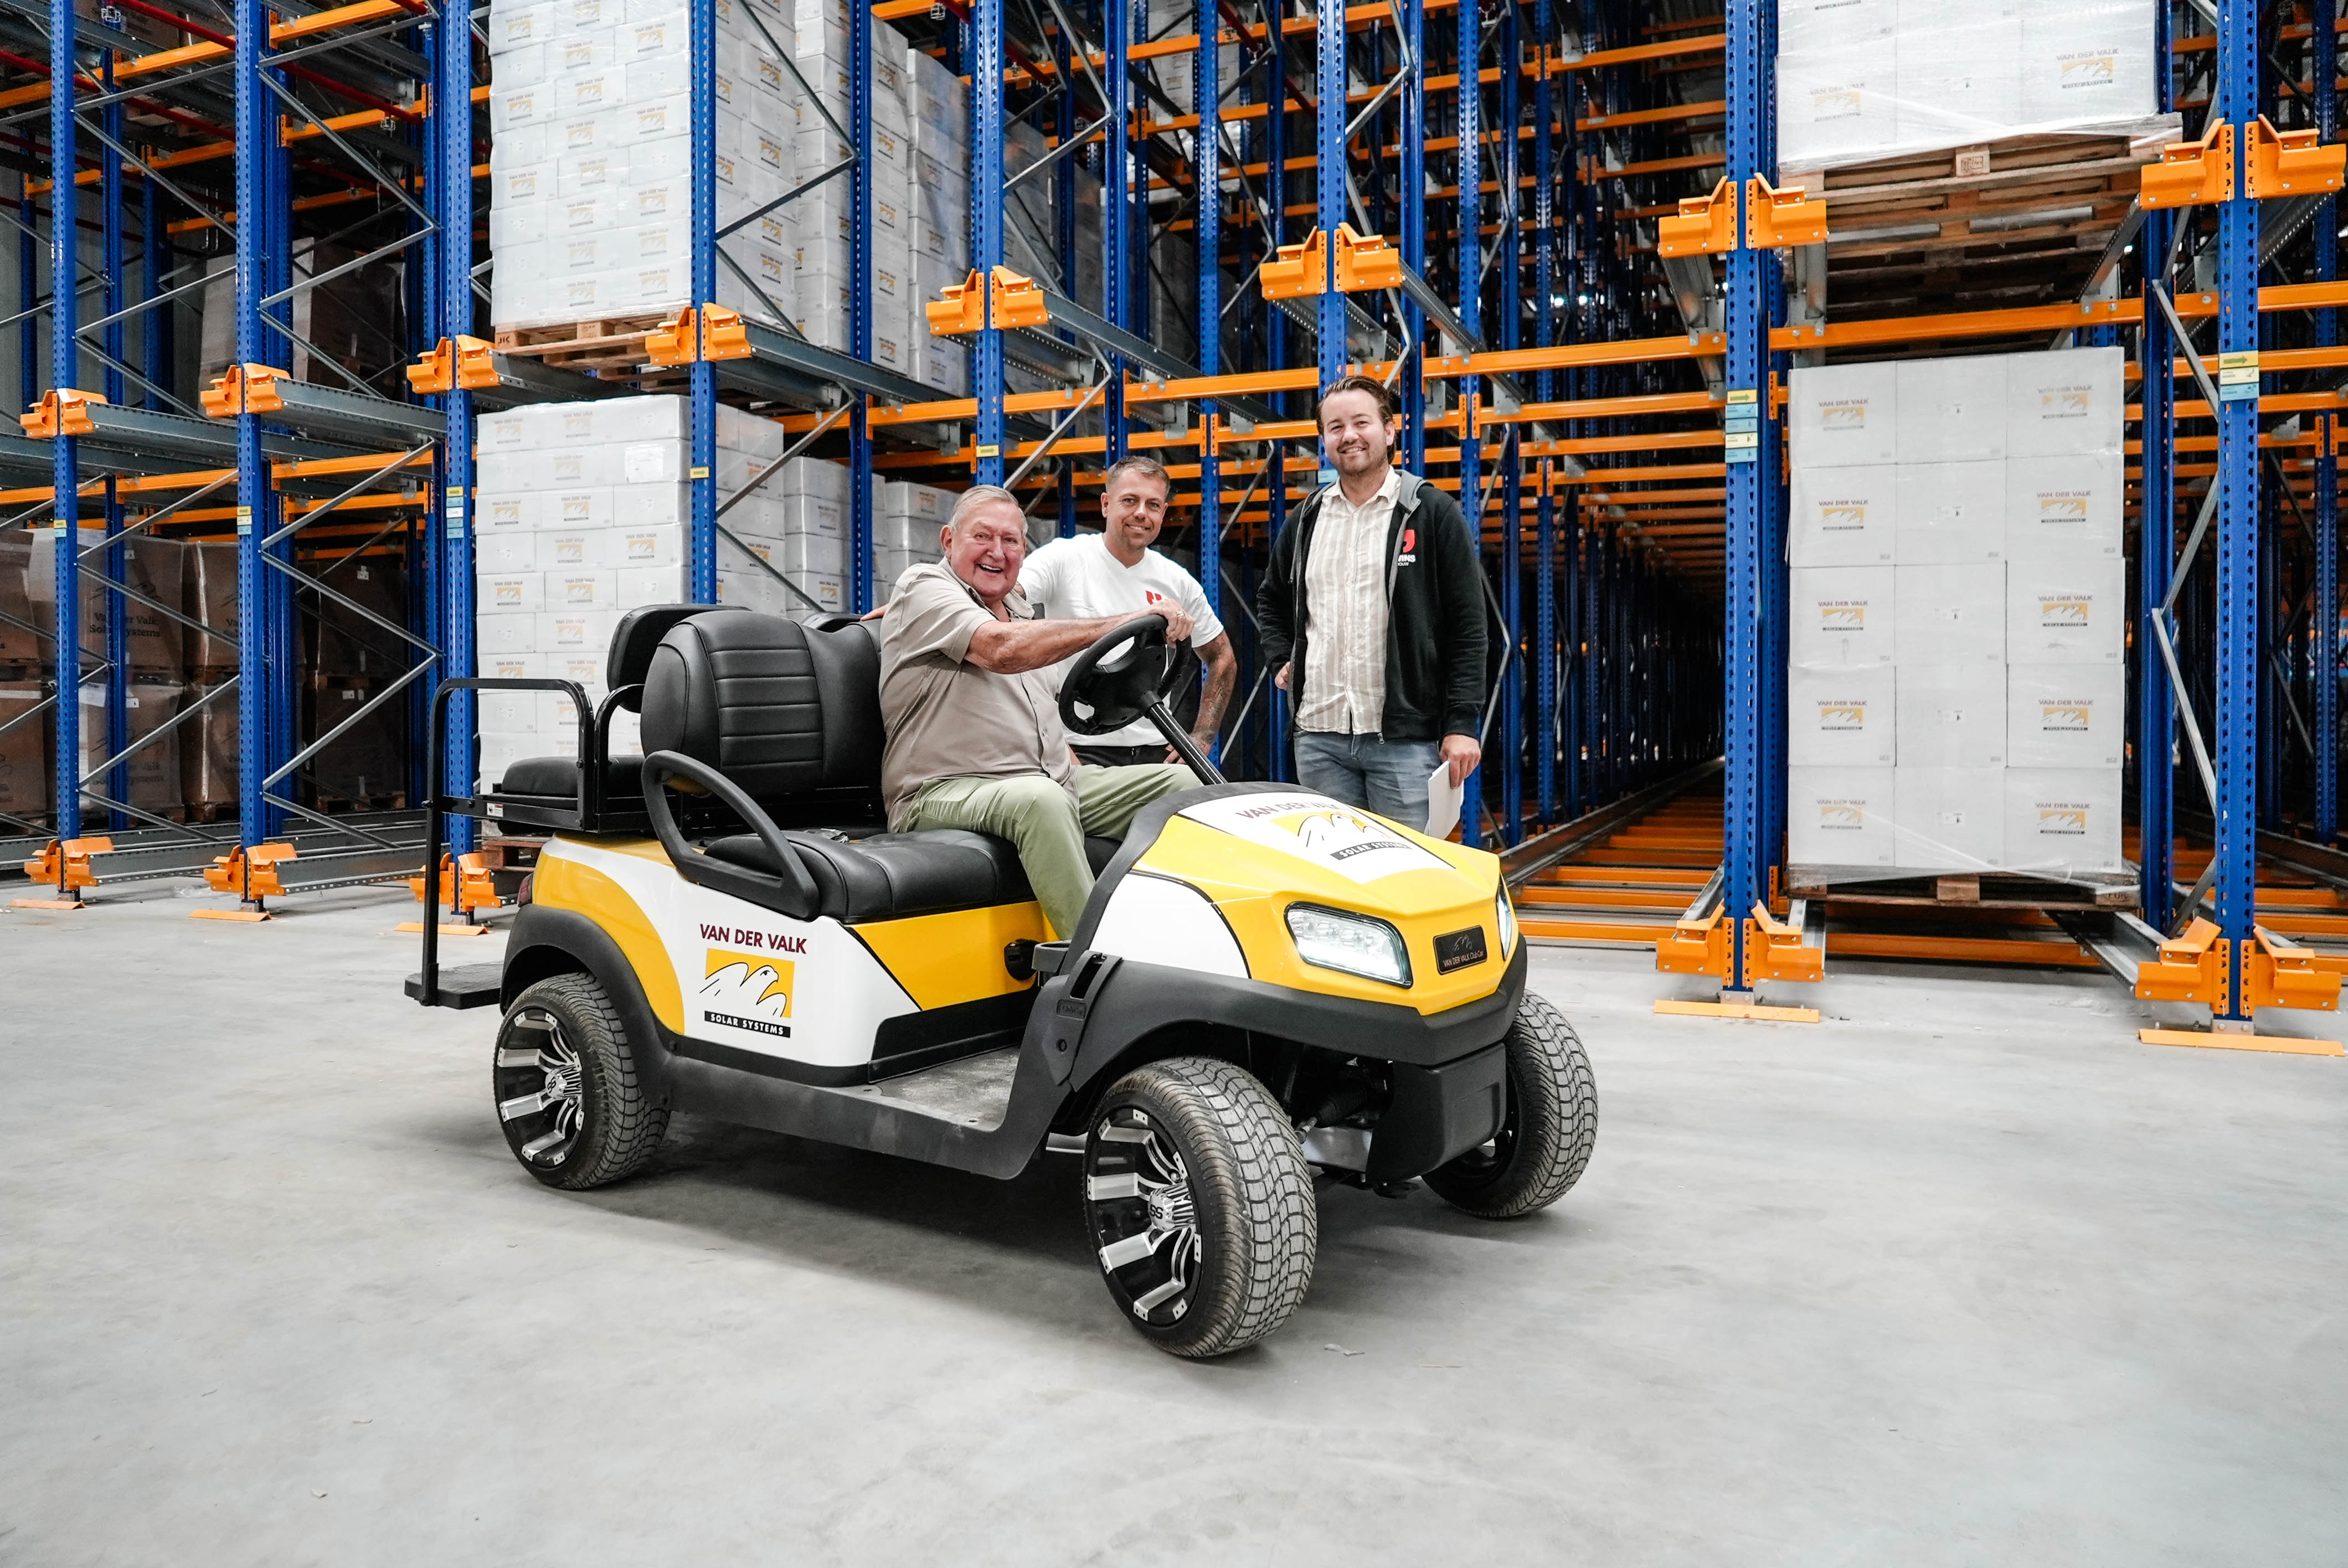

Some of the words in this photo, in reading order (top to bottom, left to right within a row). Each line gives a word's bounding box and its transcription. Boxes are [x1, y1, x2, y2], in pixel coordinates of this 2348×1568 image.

[126, 628, 161, 638] ystems
[1235, 806, 1280, 819] VAN
[1338, 844, 1372, 858] SOLAR
[700, 924, 730, 942] VAN
[734, 929, 763, 947] DER
[768, 933, 808, 954] VALK
[1443, 958, 1453, 967] VAN
[1452, 956, 1460, 965] DER
[1460, 953, 1470, 962] VALK
[710, 1013, 739, 1027] SOLAR
[743, 1019, 784, 1035] SYSTEMS
[1150, 1204, 1164, 1220] SS
